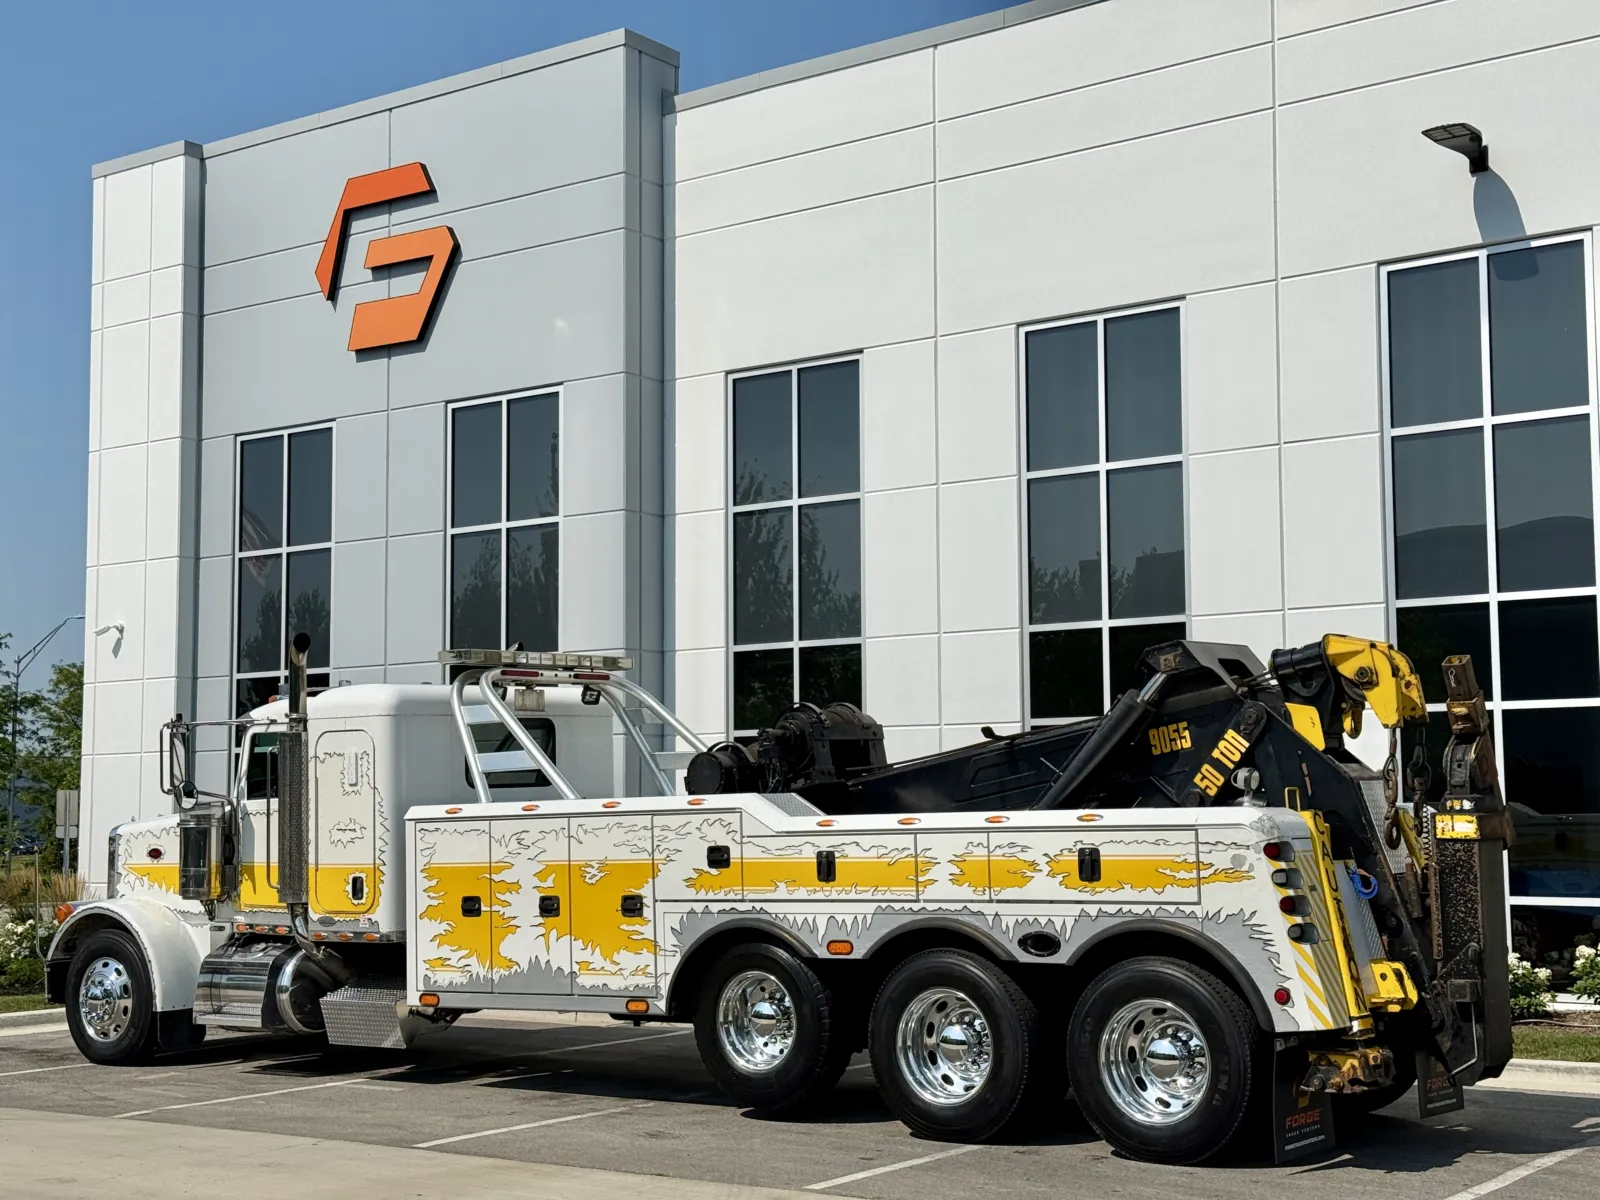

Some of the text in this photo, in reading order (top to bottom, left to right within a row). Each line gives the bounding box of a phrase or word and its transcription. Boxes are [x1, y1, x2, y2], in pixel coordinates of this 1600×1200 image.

[1148, 721, 1192, 755] 9055
[1193, 728, 1250, 797] 50 TON
[1313, 811, 1368, 1013] CAUTON
[1427, 1075, 1451, 1092] FORG
[1285, 1108, 1322, 1130] FORGE
